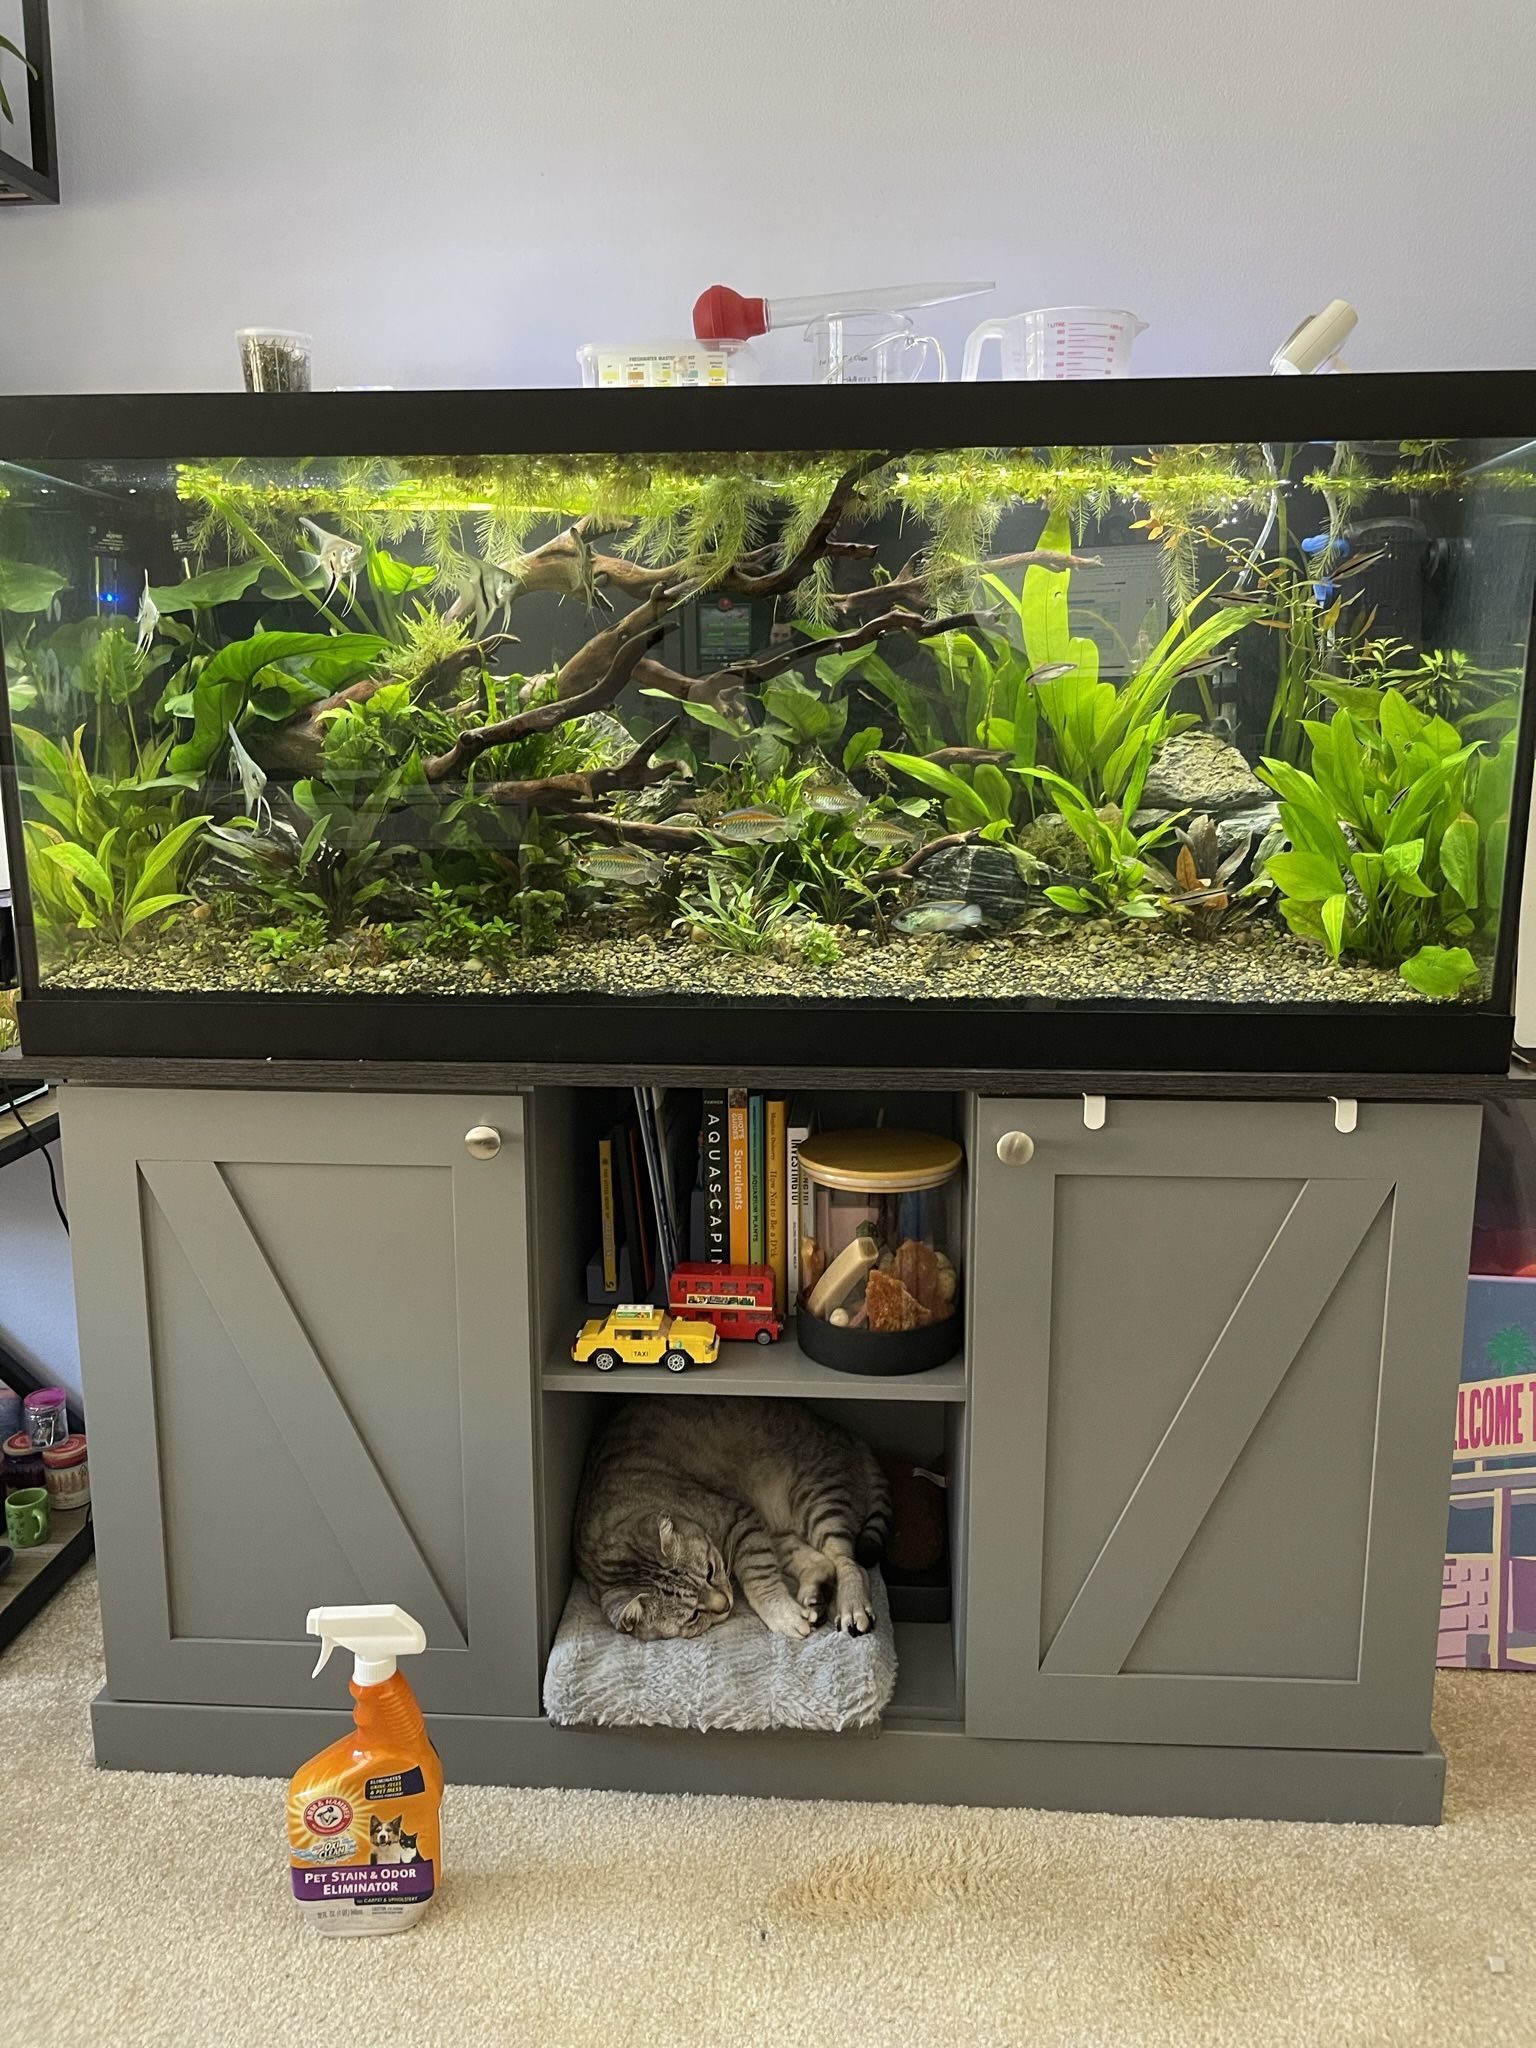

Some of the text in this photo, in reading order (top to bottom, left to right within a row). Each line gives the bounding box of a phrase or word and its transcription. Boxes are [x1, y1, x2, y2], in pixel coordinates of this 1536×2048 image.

[734, 1149, 744, 1210] Succulents
[770, 1208, 777, 1217] to
[770, 1219, 777, 1231] Be
[369, 1871, 378, 1880] &
[323, 1882, 399, 1895] ELIMINATOR
